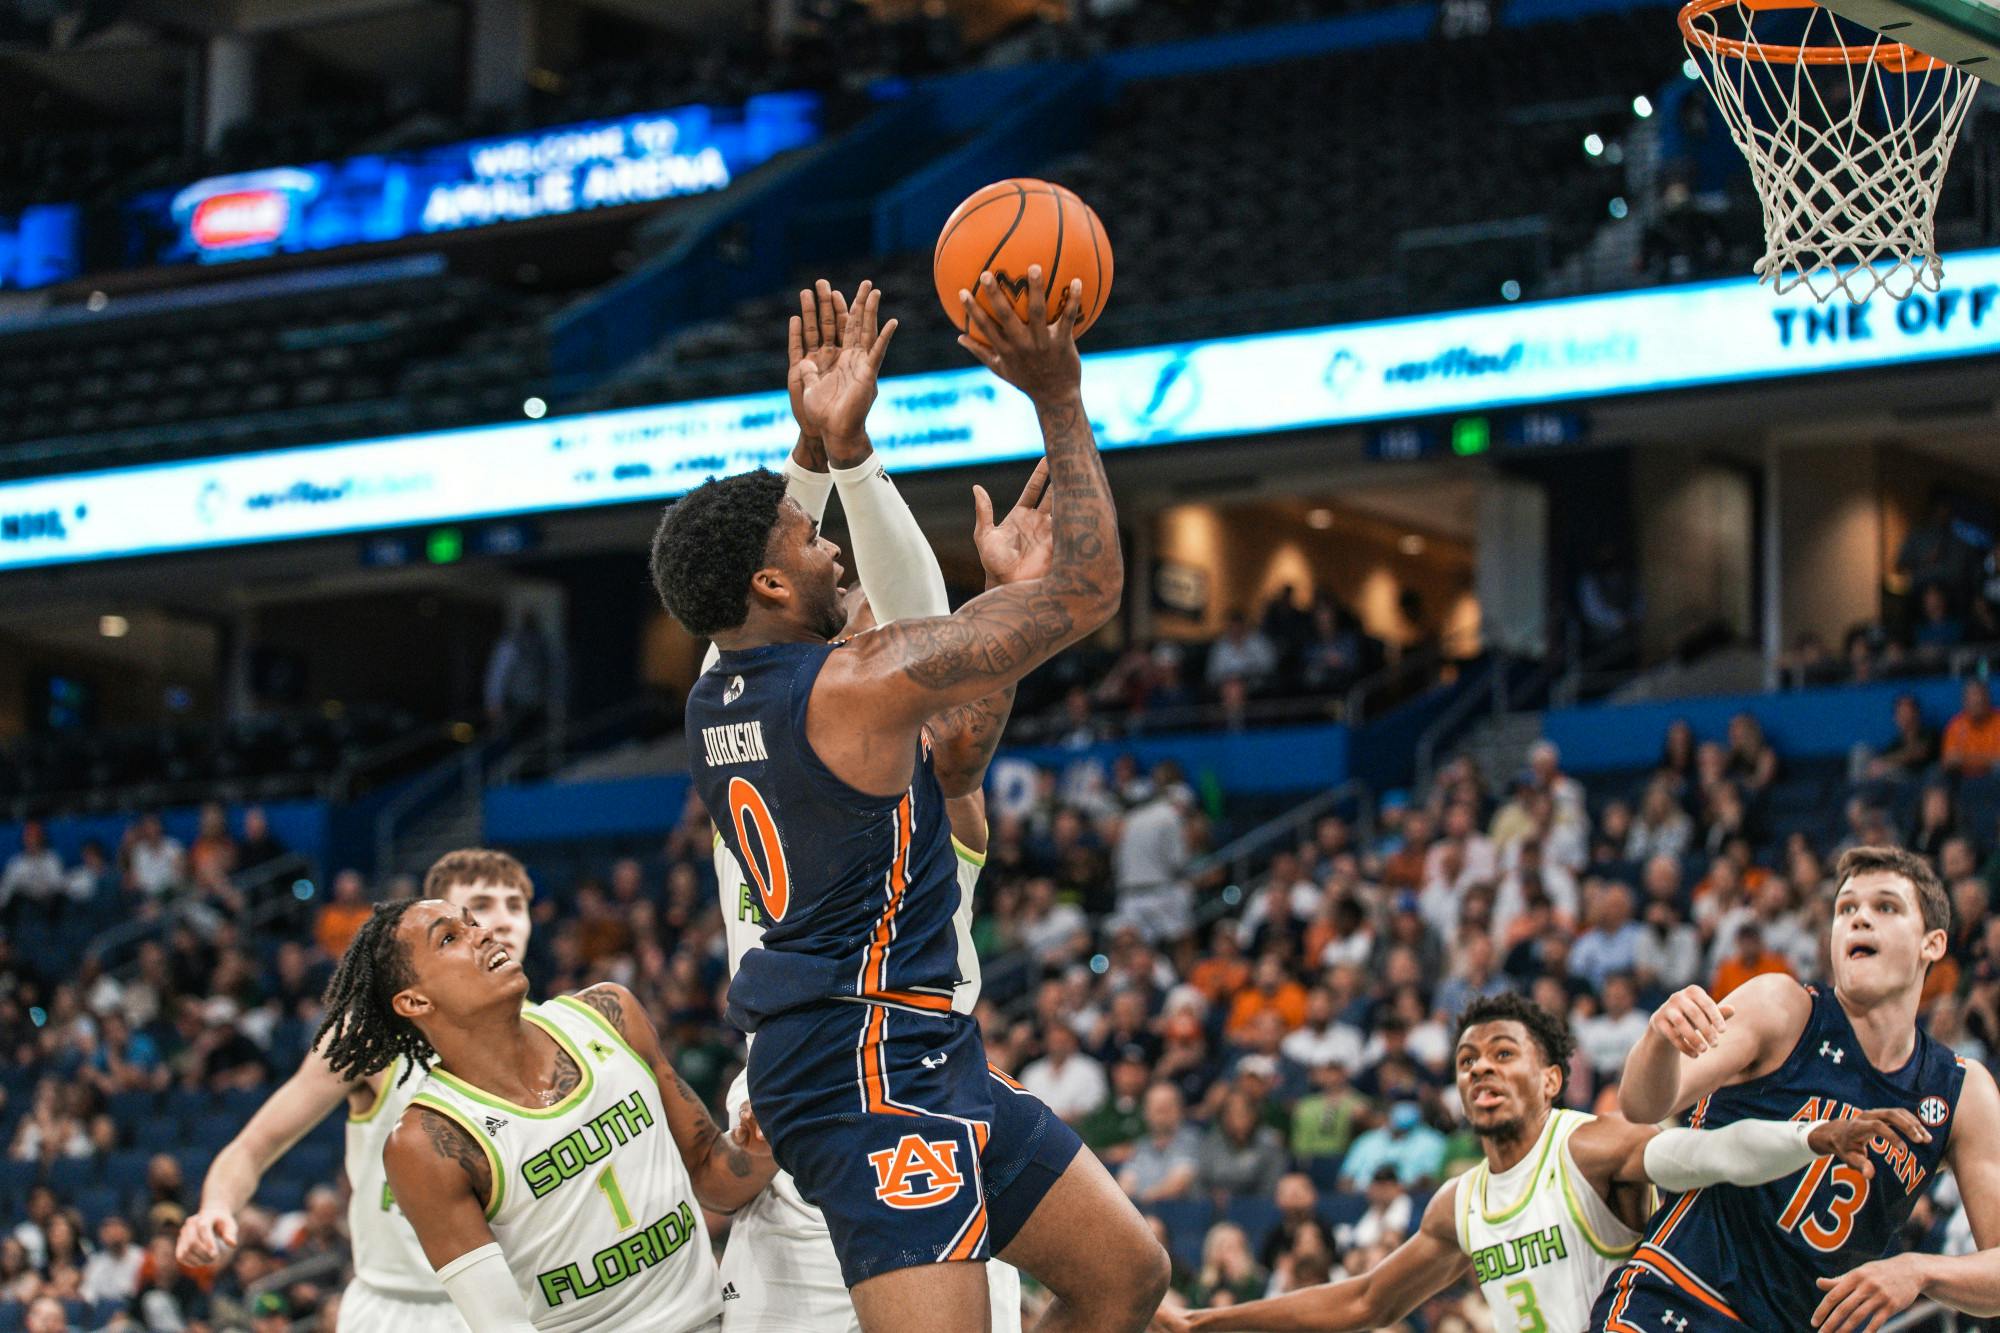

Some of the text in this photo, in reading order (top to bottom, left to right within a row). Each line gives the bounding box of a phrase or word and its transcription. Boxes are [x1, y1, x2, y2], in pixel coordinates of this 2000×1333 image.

[1772, 301, 1873, 347] THE
[702, 720, 769, 768] JOHNSON
[728, 776, 790, 923] 0
[1919, 1097, 1946, 1124] SEC
[521, 1090, 654, 1199] SOUTH
[596, 1161, 637, 1233] 1
[1777, 1153, 1870, 1253] 13
[537, 1200, 697, 1307] FLORIDA
[1471, 1224, 1568, 1285] SOUTH
[1504, 1276, 1550, 1333] 3
